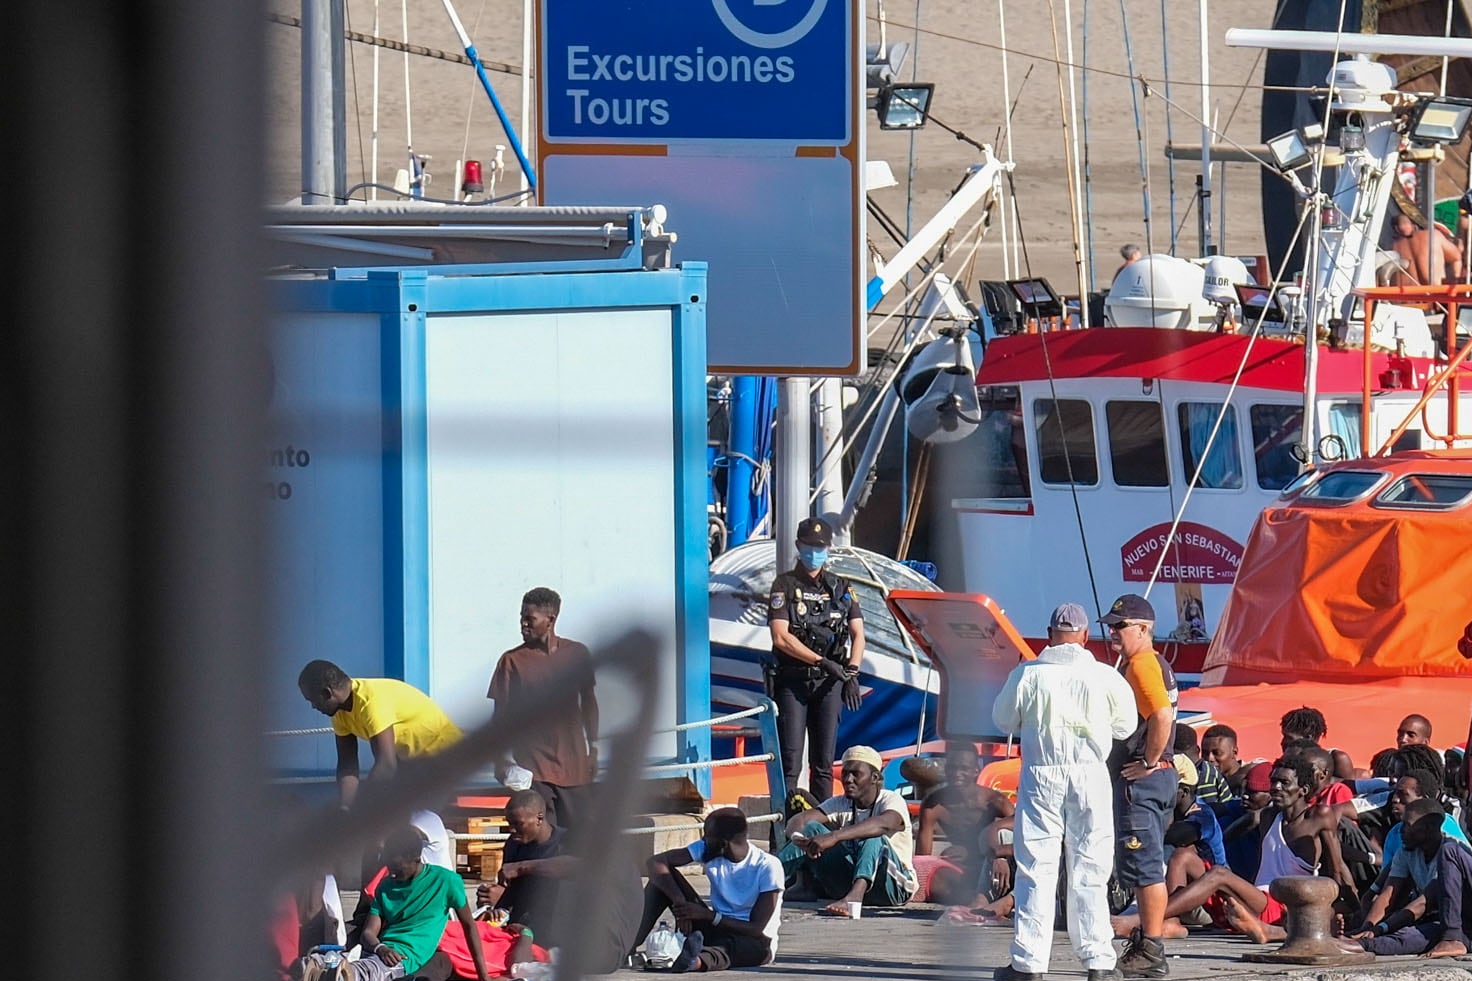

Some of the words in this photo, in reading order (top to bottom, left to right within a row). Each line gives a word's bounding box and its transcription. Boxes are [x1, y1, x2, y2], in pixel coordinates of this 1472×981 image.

[567, 46, 796, 83] Excursiones
[566, 89, 671, 126] Tours
[271, 444, 310, 468] nto
[1124, 537, 1158, 567] NUEVO
[1158, 565, 1215, 579] TENERIFE
